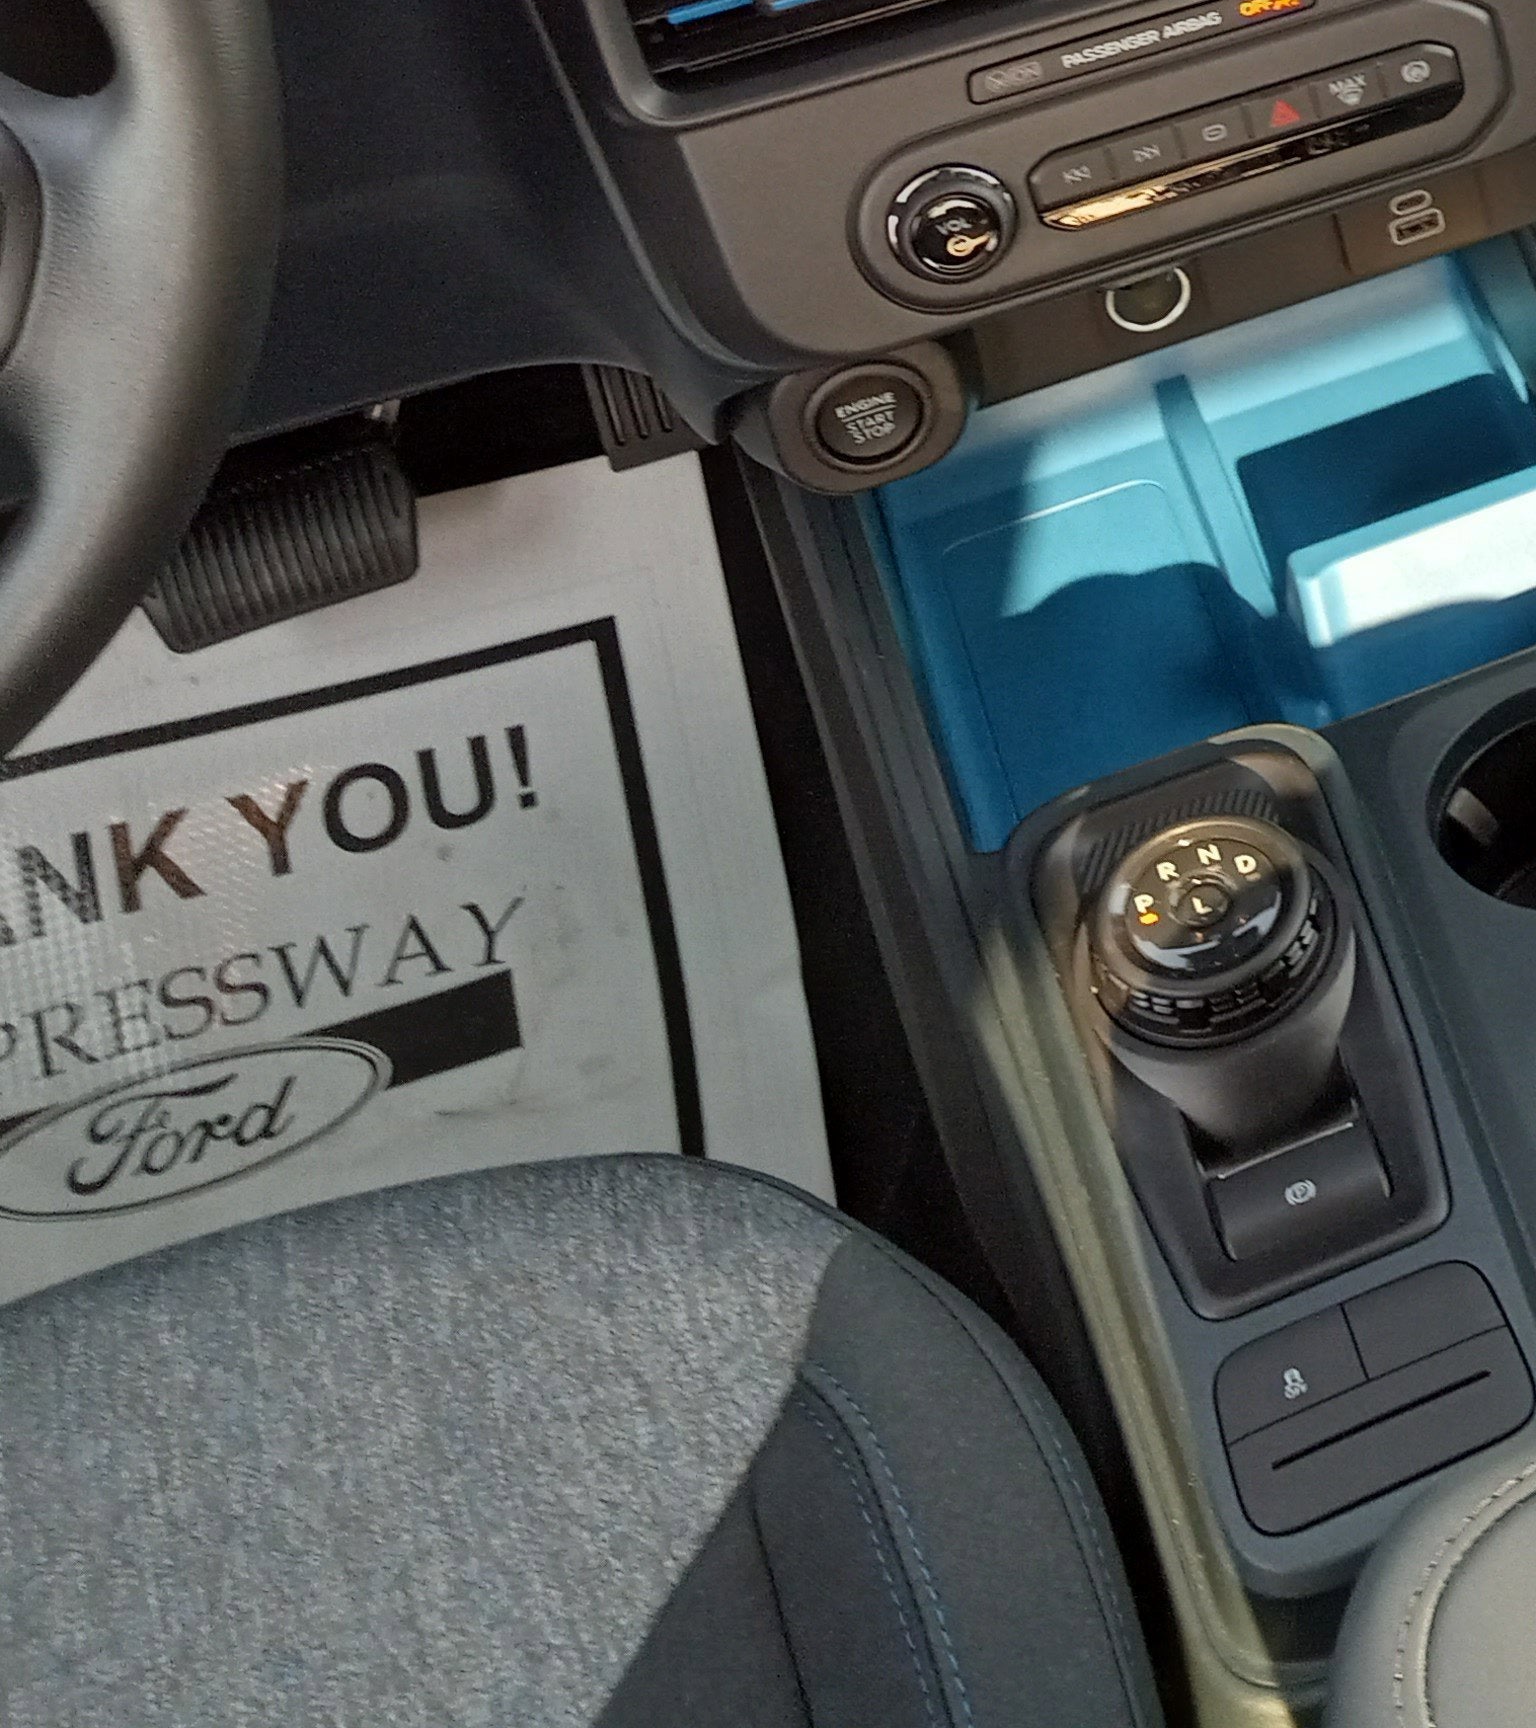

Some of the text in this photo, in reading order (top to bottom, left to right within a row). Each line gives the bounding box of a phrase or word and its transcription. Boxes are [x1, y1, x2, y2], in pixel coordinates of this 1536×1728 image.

[1060, 11, 1223, 69] PASSENGER AIRBAG
[1328, 74, 1367, 96] MAX
[834, 391, 897, 418] ENGINE
[845, 410, 895, 434] START
[851, 421, 896, 444] STOP
[0, 725, 538, 947] NK YOU!
[1134, 843, 1257, 913] P R N D
[1192, 896, 1213, 915] L
[65, 1074, 297, 1197] Ford
